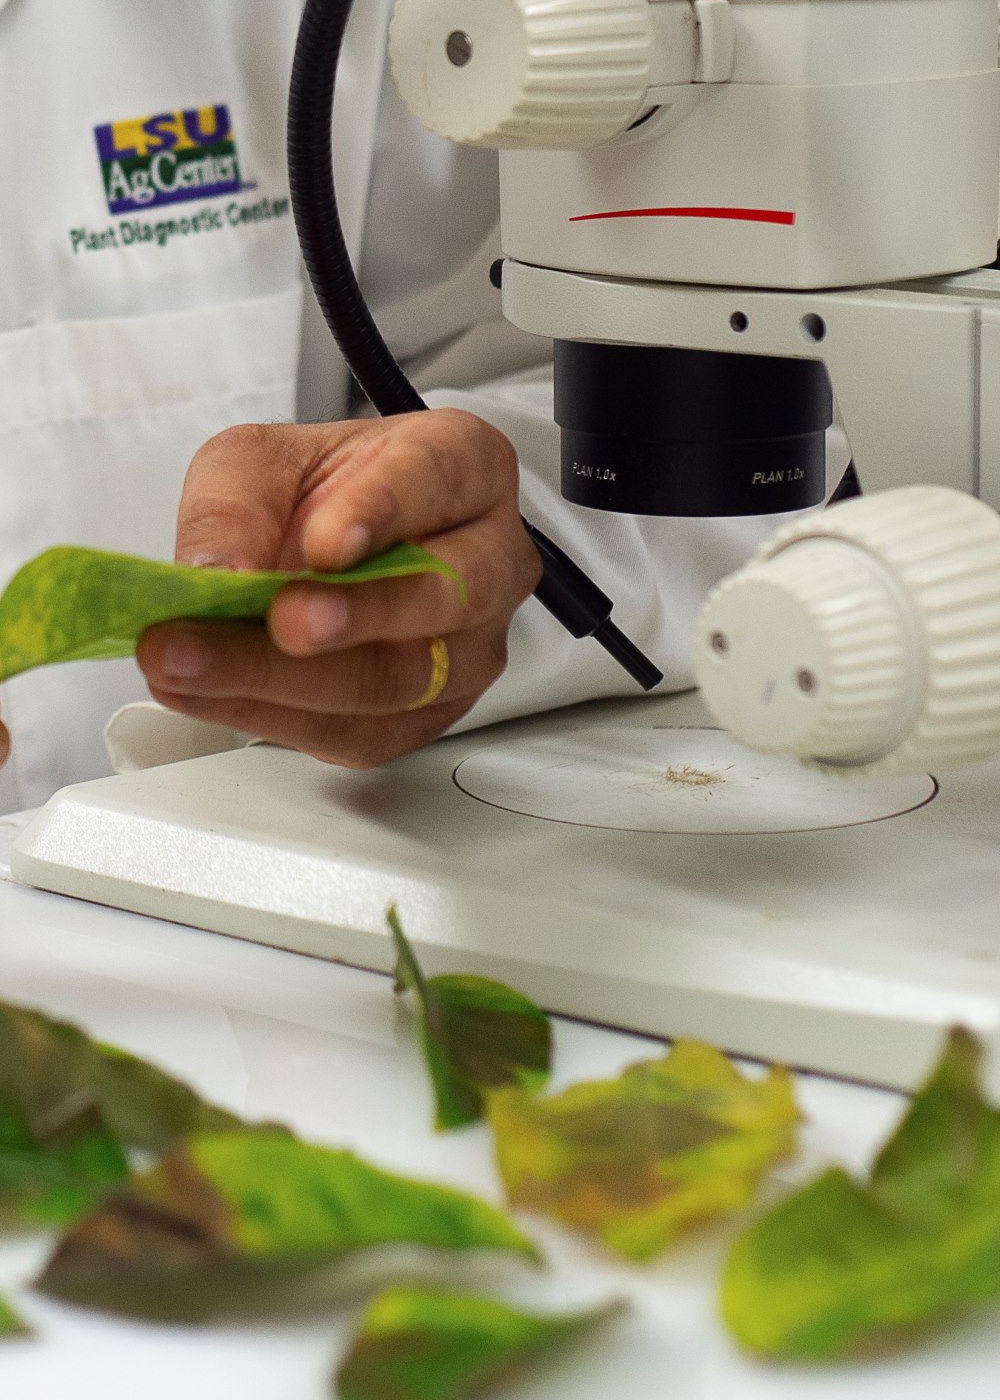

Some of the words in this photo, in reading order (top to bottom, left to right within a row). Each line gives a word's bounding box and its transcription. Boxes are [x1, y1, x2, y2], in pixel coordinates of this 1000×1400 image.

[94, 104, 231, 162] LSU
[108, 150, 236, 204] AgCenter
[69, 226, 118, 253] Plant
[119, 206, 222, 246] Diagnostic
[226, 197, 289, 226] Center
[572, 461, 594, 479] PLAN
[596, 467, 617, 482] 1.0x
[751, 469, 785, 485] PLAN
[786, 467, 805, 482] 1.0x
